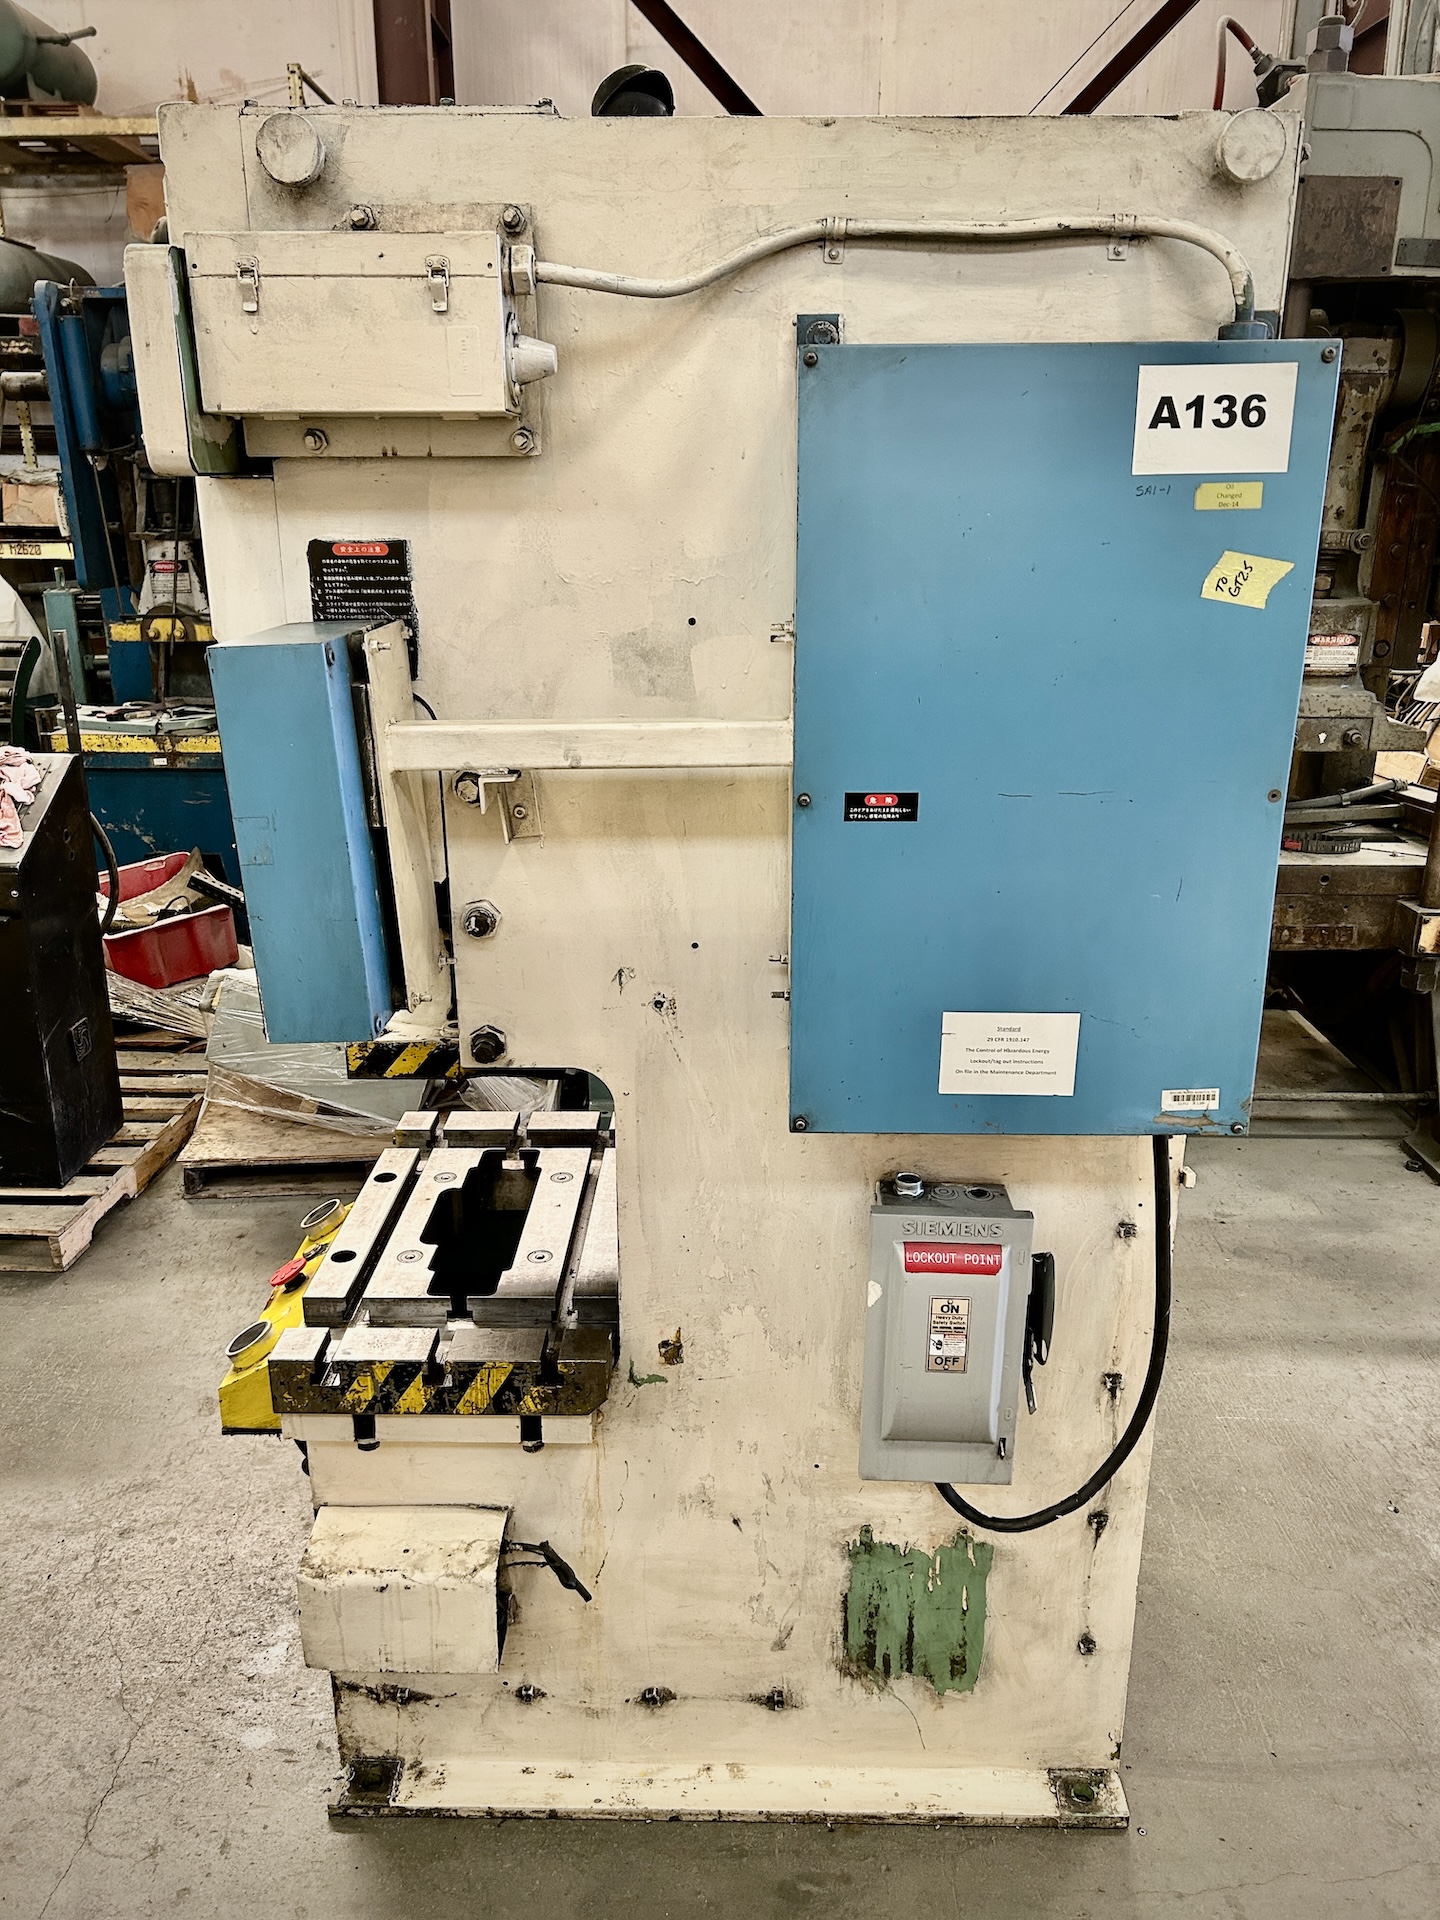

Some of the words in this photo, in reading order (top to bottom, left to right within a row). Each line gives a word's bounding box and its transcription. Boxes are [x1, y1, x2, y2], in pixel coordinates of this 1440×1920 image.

[1148, 394, 1267, 429] A136
[1215, 576, 1228, 592] TO
[902, 1221, 1004, 1238] SIEMENS
[906, 1252, 957, 1264] LOCKOUT
[964, 1254, 1001, 1265] POINT
[940, 1304, 960, 1313] ON
[934, 1356, 960, 1366] OFF
